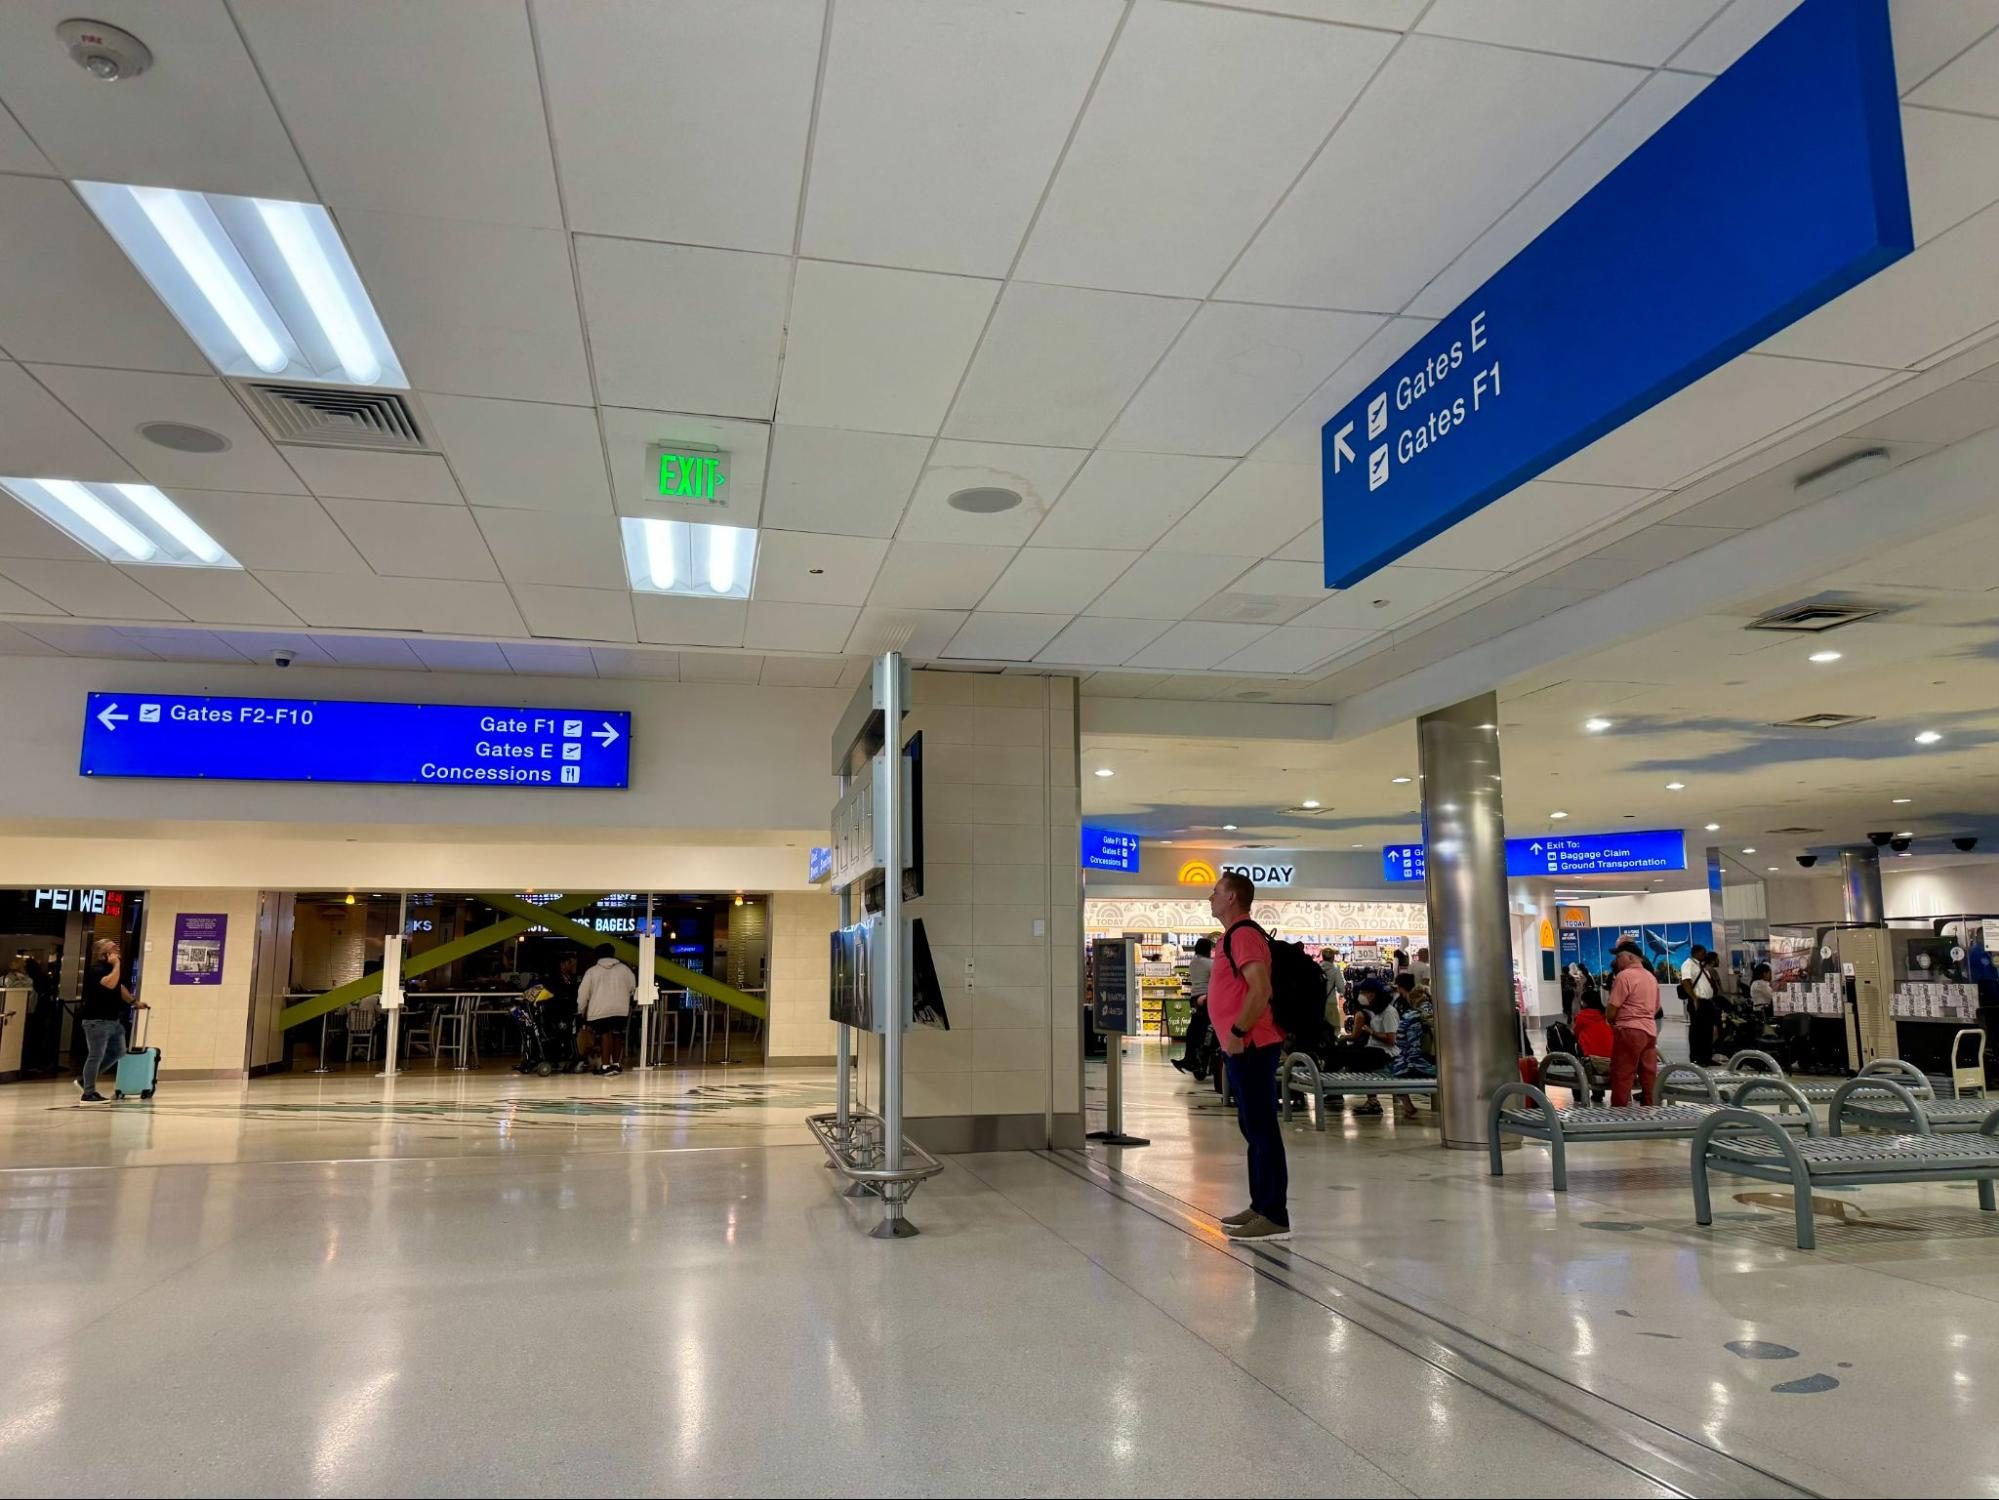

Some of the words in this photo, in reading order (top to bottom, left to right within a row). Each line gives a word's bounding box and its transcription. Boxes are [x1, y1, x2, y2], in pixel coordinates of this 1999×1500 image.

[1396, 341, 1463, 411] Gates
[1471, 310, 1487, 353] E
[1398, 397, 1466, 464] Gates
[1473, 360, 1501, 412] F1
[660, 453, 720, 500] EXIT
[170, 705, 233, 723] Gates
[240, 707, 313, 726] F2-F10
[480, 716, 528, 733] Gate
[534, 718, 555, 734] F1
[475, 741, 534, 758] Gates
[540, 743, 554, 759] E
[420, 762, 552, 782] Concessions
[1547, 842, 1564, 850] Exit
[1566, 841, 1580, 849] To:
[1090, 856, 1121, 866] Concessions
[1560, 851, 1601, 861] Baggage
[1603, 849, 1630, 858] Claim
[1561, 861, 1595, 870] Ground
[1597, 858, 1667, 869] Transportation
[1223, 866, 1293, 882] TODAY
[595, 917, 636, 932] BAGELS
[1096, 918, 1124, 926] TODAY
[1361, 918, 1406, 929] TODAY
